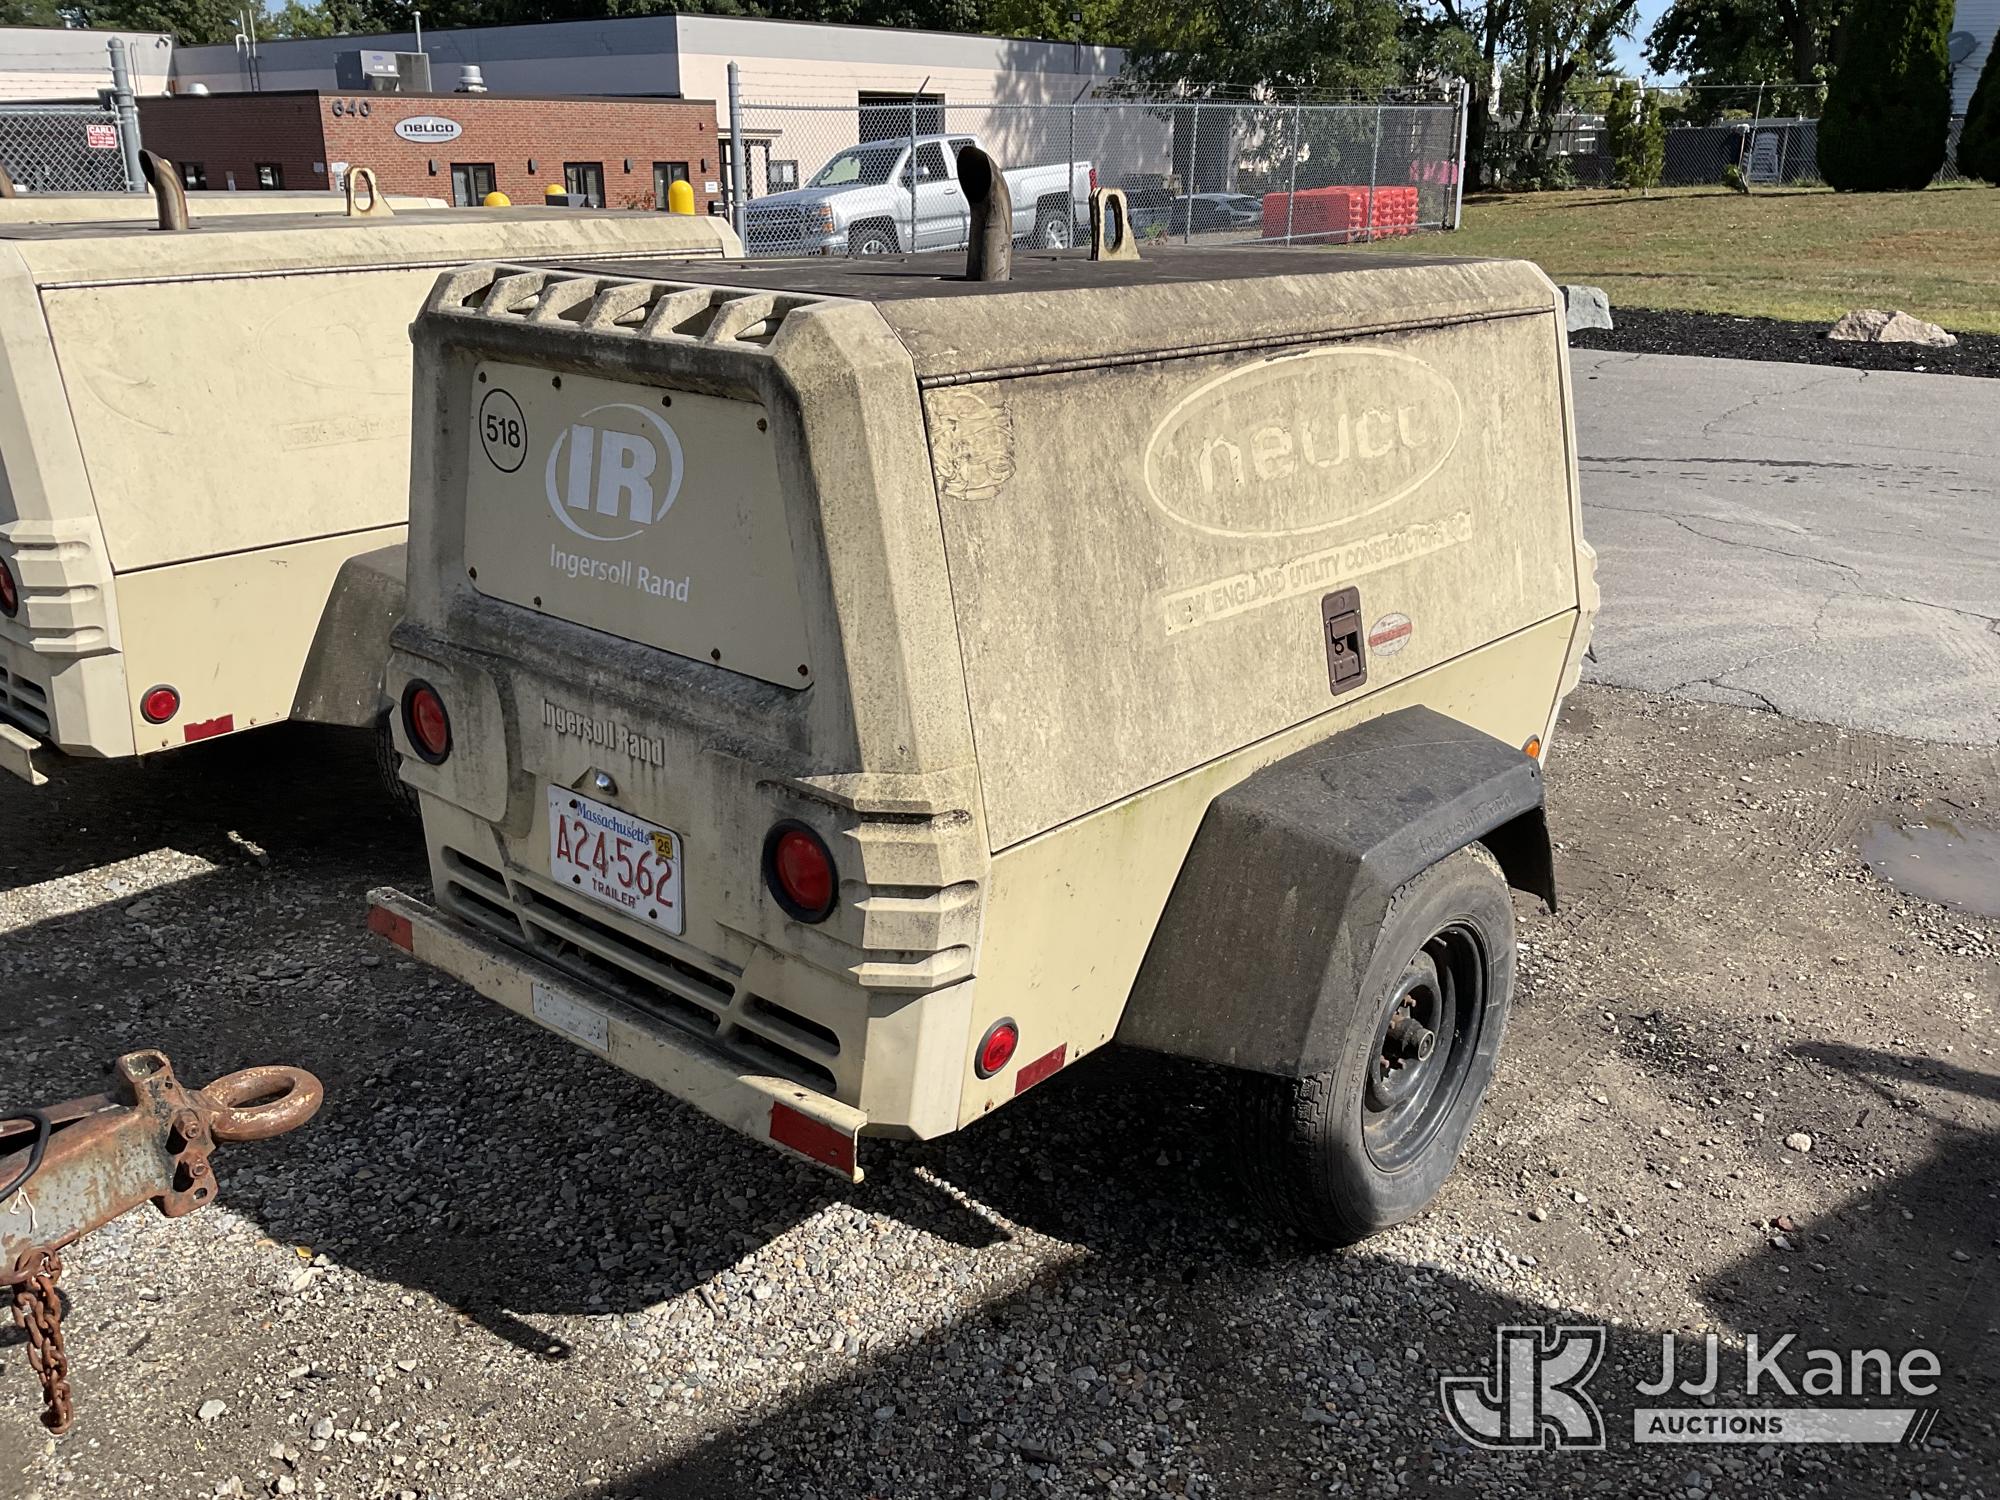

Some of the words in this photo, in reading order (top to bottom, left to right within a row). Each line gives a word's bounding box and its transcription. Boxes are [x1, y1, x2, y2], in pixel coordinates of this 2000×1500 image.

[332, 98, 371, 117] 640
[404, 123, 454, 132] neuco
[486, 414, 521, 448] 518
[567, 423, 657, 525] IR
[550, 544, 631, 587] Ingersoll
[638, 566, 690, 603] Rand
[1289, 553, 1340, 588] UTILITY
[542, 699, 616, 750] Ingersoll
[617, 725, 665, 768] Rand
[576, 800, 650, 846] Massachusetts
[657, 837, 670, 855] 26
[592, 877, 637, 909] TRAILER
